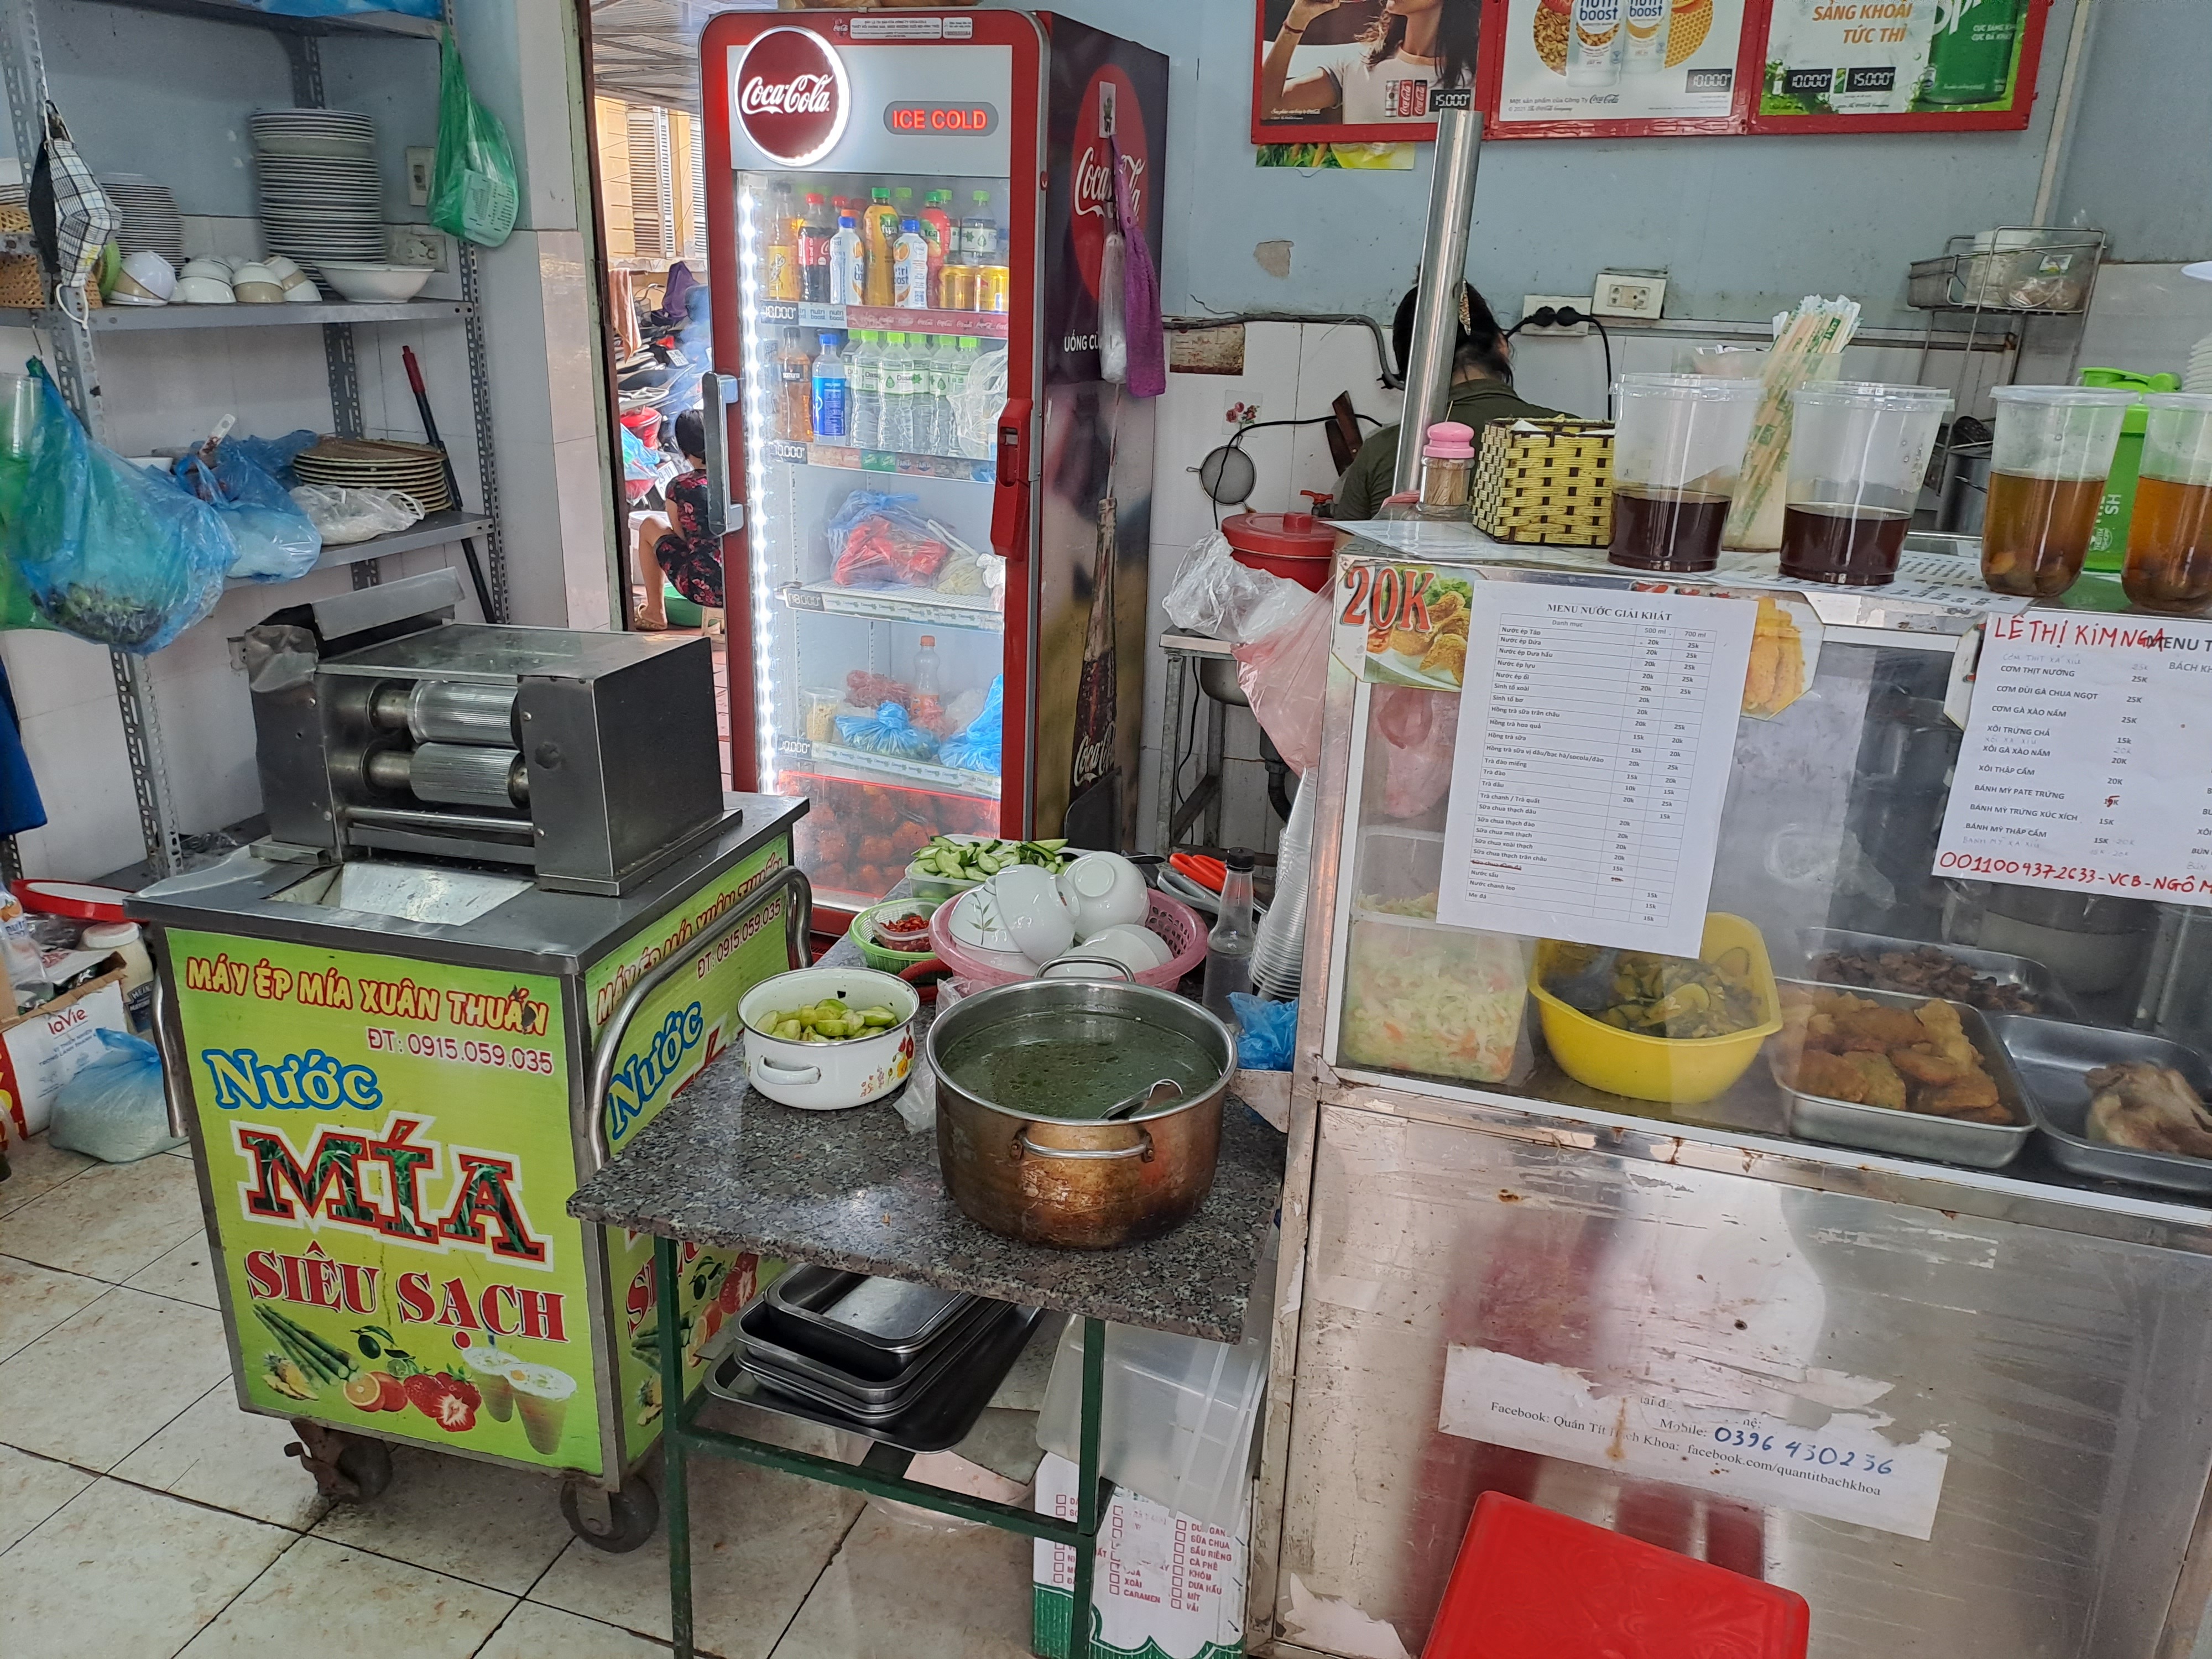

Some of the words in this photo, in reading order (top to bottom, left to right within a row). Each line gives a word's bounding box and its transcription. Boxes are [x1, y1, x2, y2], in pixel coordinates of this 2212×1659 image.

[1579, 8, 1619, 21] boost
[1629, 5, 1663, 17] boost
[1844, 24, 1876, 44] TỨC
[740, 74, 834, 114] Coca-Cola
[893, 109, 926, 129] ICE
[932, 109, 987, 131] COLD
[1063, 328, 1088, 353] UỐNG
[1340, 565, 1435, 634] 20K
[1547, 603, 1578, 613] MENU
[1580, 605, 1613, 616] NƯỚC
[1614, 607, 1638, 618] GIẢI
[1640, 610, 1672, 621] KHÁT
[1994, 614, 2025, 640] LÊ
[2042, 668, 2075, 677] NƯỚNG
[2168, 661, 2199, 672] BÁCH
[2131, 675, 2148, 683] 25K
[2034, 687, 2047, 695] GÀ
[2048, 689, 2072, 697] CHUA
[2125, 695, 2143, 703] 25K
[2012, 706, 2025, 714] GÀ
[2026, 707, 2045, 716] XÀO
[2120, 716, 2137, 724] 25K
[1986, 723, 2001, 732] XÔI
[2002, 726, 2032, 735] TRỨNG
[1982, 743, 1997, 753] XÔI
[1998, 745, 2010, 754] GÀ
[2011, 747, 2030, 755] XÀO
[2110, 757, 2127, 765] 20K
[1974, 783, 1997, 792] BÁNH
[2012, 787, 2033, 796] PATE
[2034, 790, 2065, 800] TRỨNG
[1969, 803, 1993, 812] BÁNH
[2009, 807, 2038, 817] TRỨNG
[2039, 810, 2057, 819] XÚC
[2057, 812, 2078, 821] XÍCH
[716, 897, 782, 964] 0915.059.035
[186, 952, 248, 996] MÁY
[253, 957, 293, 1000] ÉP
[298, 967, 354, 1011] MÍA
[359, 978, 441, 1022] XUÂN
[367, 1027, 404, 1052] ĐT:
[407, 1032, 554, 1076] 0915.059.035
[201, 1048, 383, 1110] Nước
[608, 1001, 704, 1141] Nước
[232, 1113, 550, 1268] MÍA
[245, 1239, 380, 1314] SIÊU
[397, 1271, 570, 1351] SẠCH
[1490, 1402, 1550, 1423] Facebook:
[1553, 1416, 1585, 1431] Quán
[1643, 1434, 1680, 1451] Khoa:
[1687, 1444, 1881, 1496] facebook.com/quantitbachkhoa
[1191, 1535, 1207, 1546] SỮA
[1208, 1538, 1230, 1550] CHUA
[1208, 1550, 1232, 1562] RIÊNG
[1202, 1559, 1218, 1572] PHÊ
[1188, 1580, 1204, 1592] DƯA
[1124, 1589, 1161, 1604] CARAMEN
